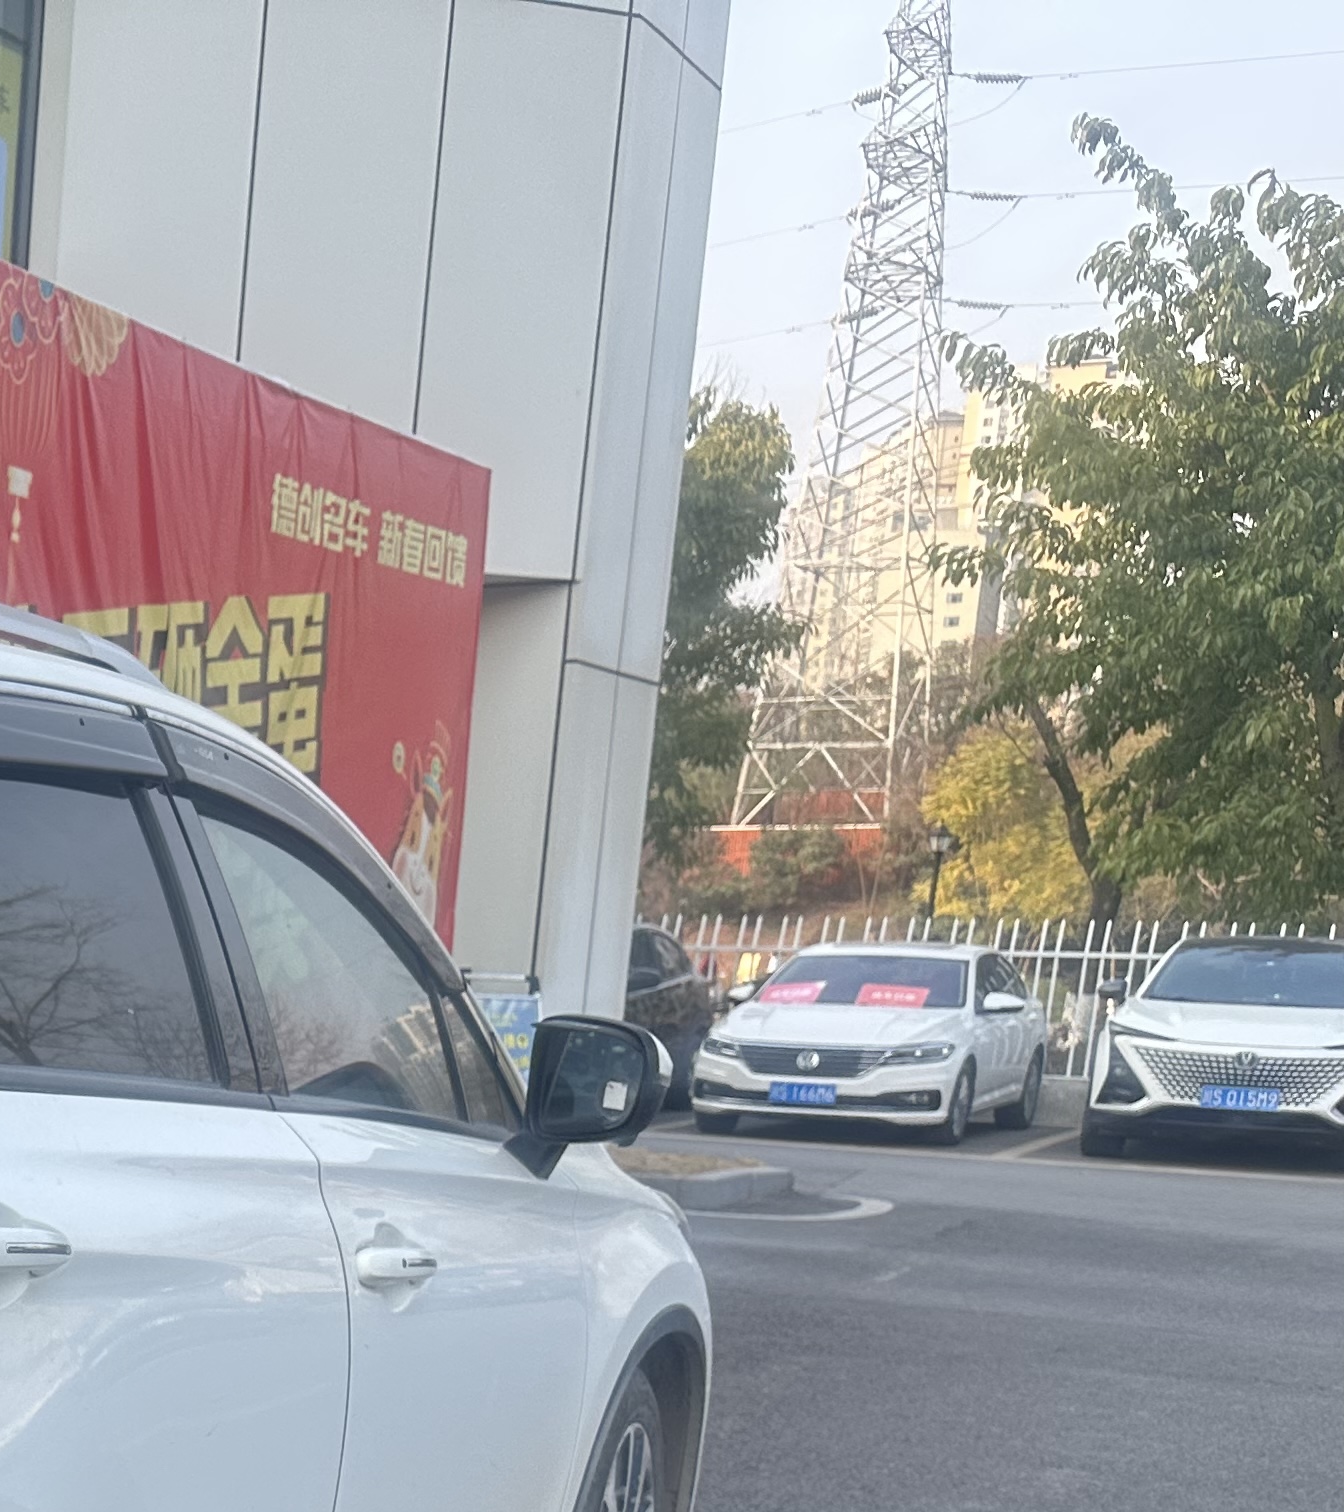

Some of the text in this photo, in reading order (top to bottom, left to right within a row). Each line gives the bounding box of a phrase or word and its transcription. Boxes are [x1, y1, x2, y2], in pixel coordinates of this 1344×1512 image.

[270, 472, 469, 598] 德创名车 新春回馈
